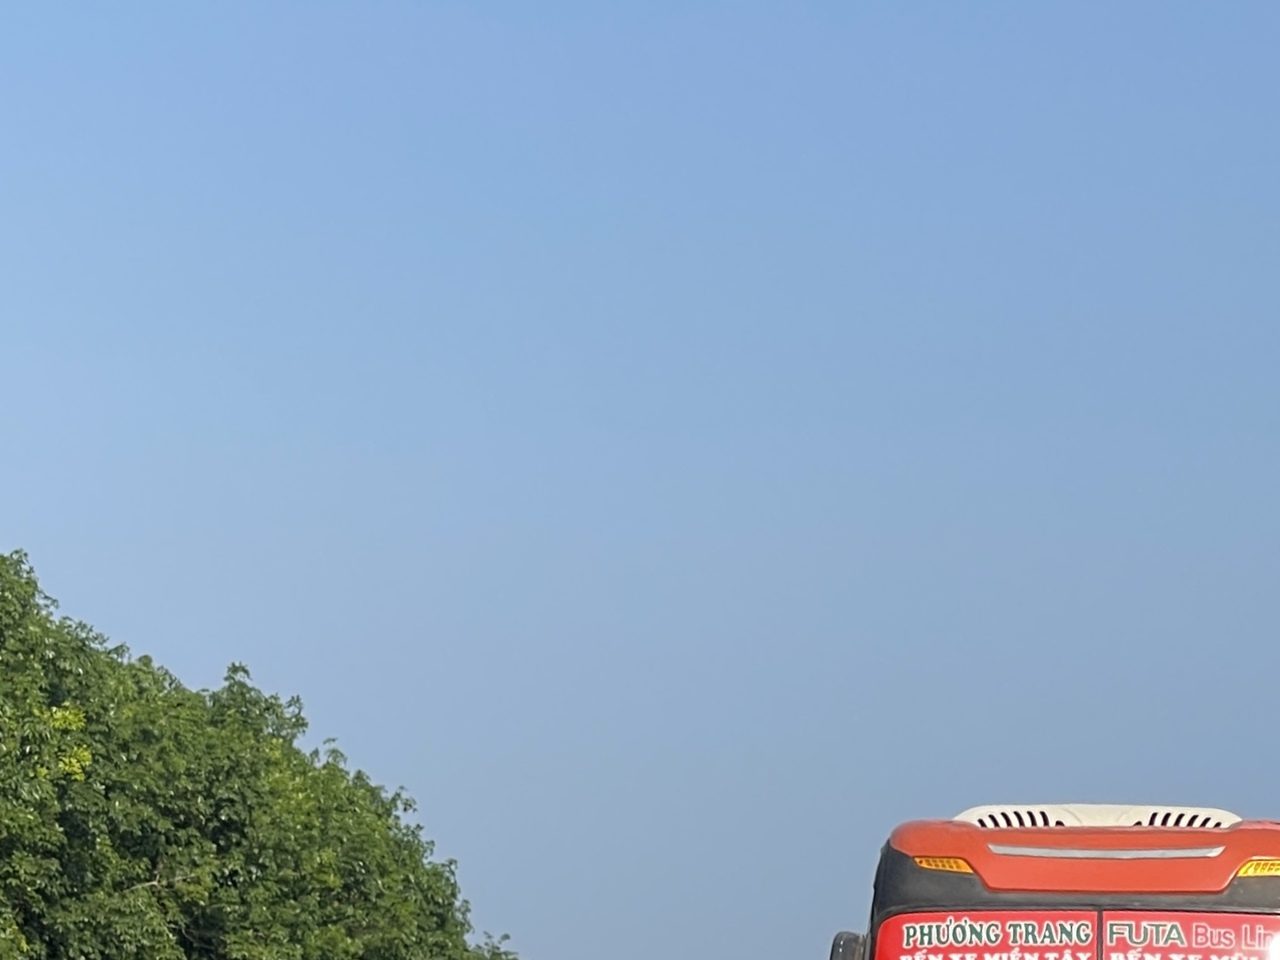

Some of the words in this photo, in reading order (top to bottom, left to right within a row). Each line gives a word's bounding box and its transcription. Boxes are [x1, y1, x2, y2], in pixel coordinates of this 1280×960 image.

[904, 916, 1002, 948] PHƯƠNG
[1007, 920, 1093, 947] TRANG
[1107, 920, 1188, 948] FUTA
[1192, 922, 1236, 949] Bus
